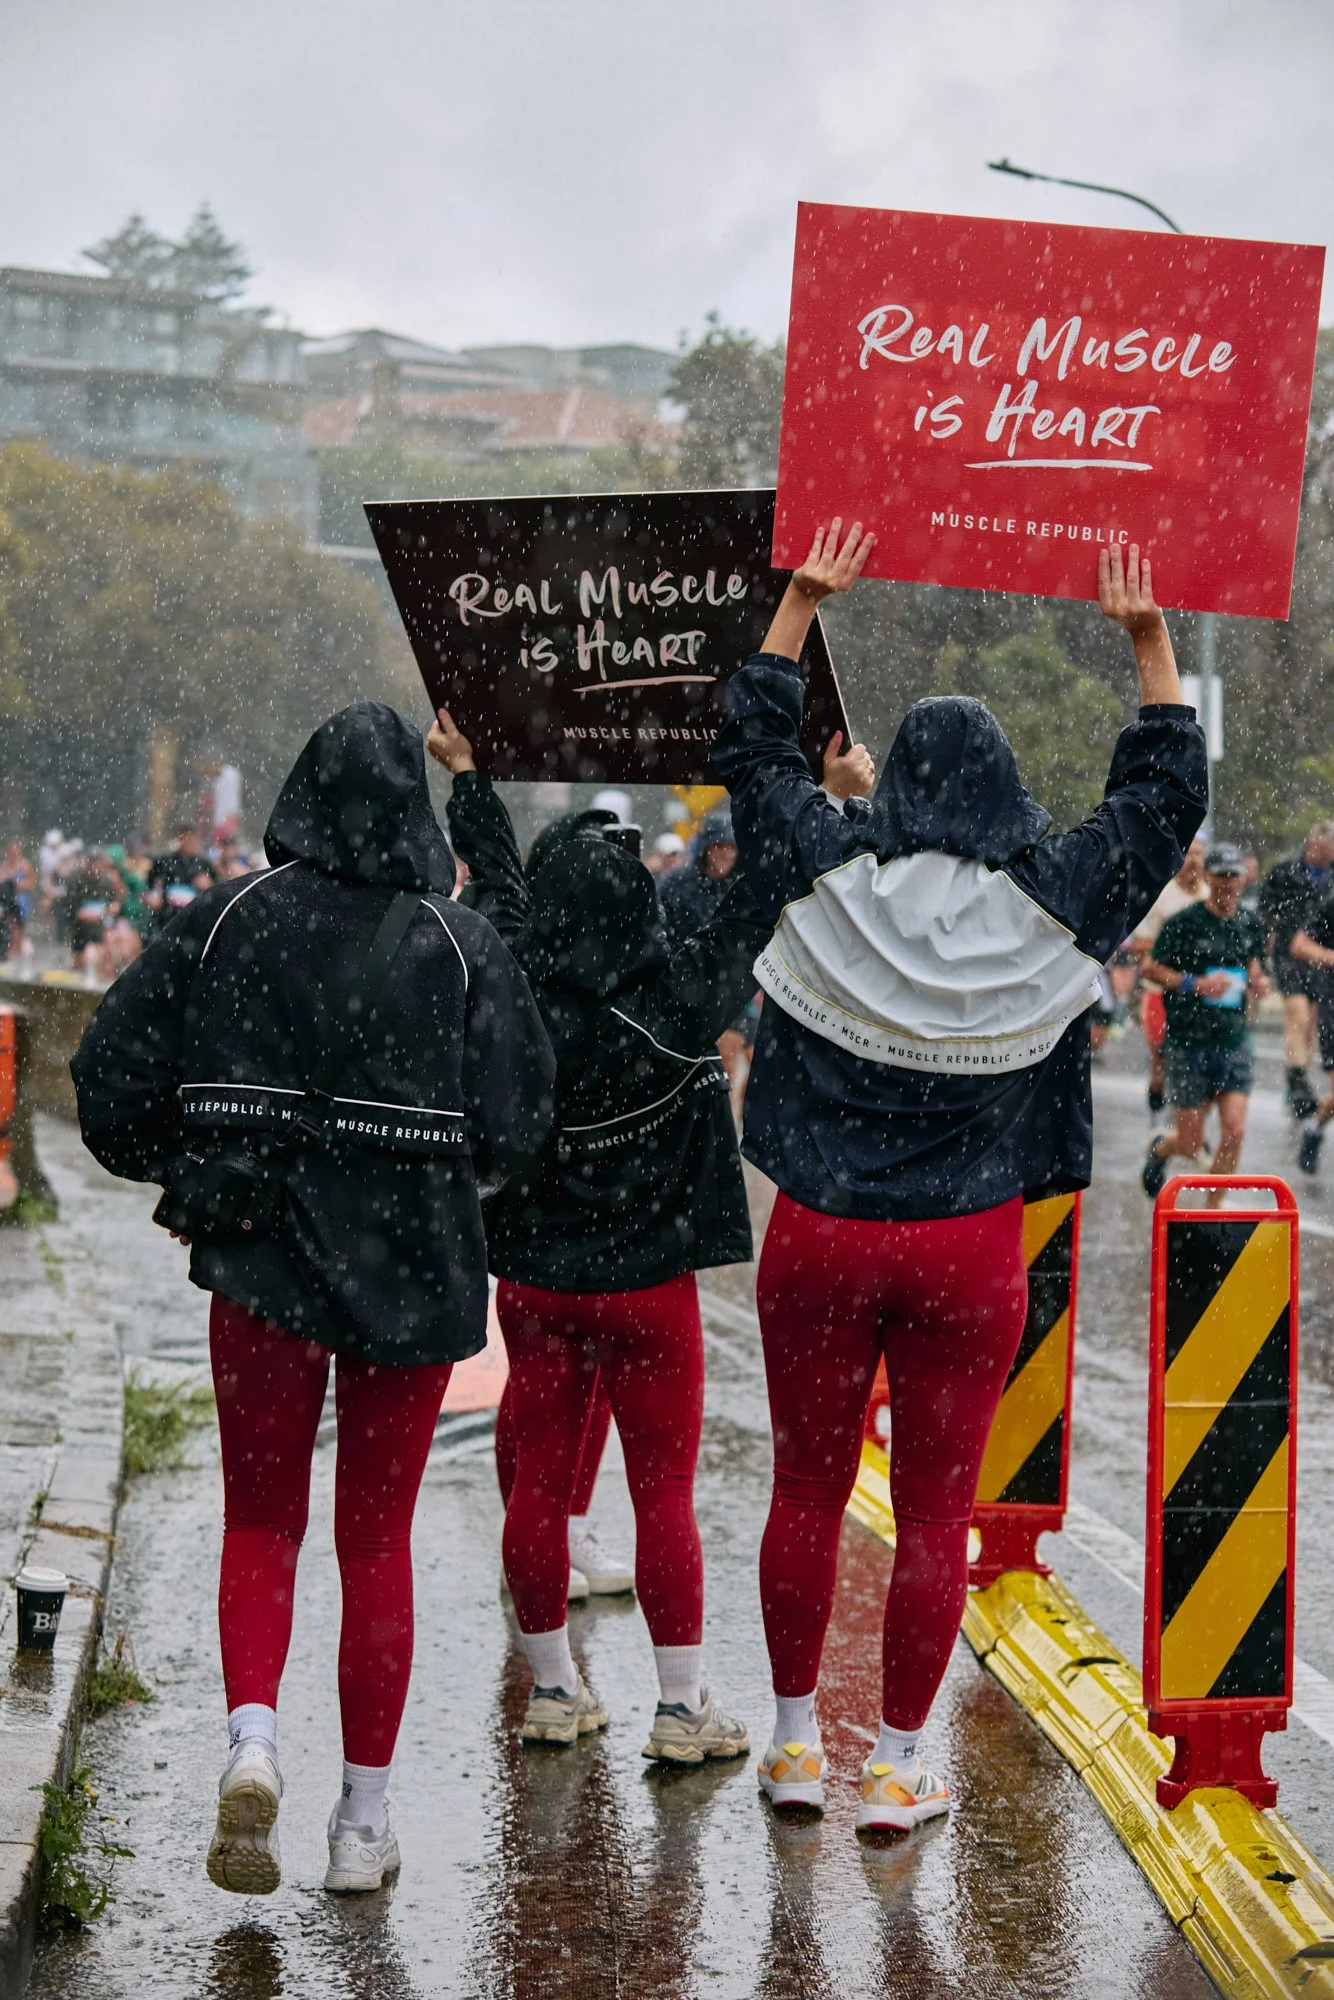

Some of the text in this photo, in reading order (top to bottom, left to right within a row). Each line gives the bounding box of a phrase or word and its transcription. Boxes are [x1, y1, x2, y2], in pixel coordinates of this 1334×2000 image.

[931, 511, 1129, 545] MUSCLE REPUBLIC
[563, 727, 632, 740] MUSCLE
[782, 985, 827, 1023] REPUBLIC
[841, 1026, 870, 1048] MSCR
[887, 1045, 939, 1063] MUSCLE
[946, 1053, 1010, 1065] REPUBLIC
[336, 1118, 389, 1136] MUSCLE
[395, 1127, 464, 1143] REPUBLIC
[587, 1131, 635, 1150] MUSCLE
